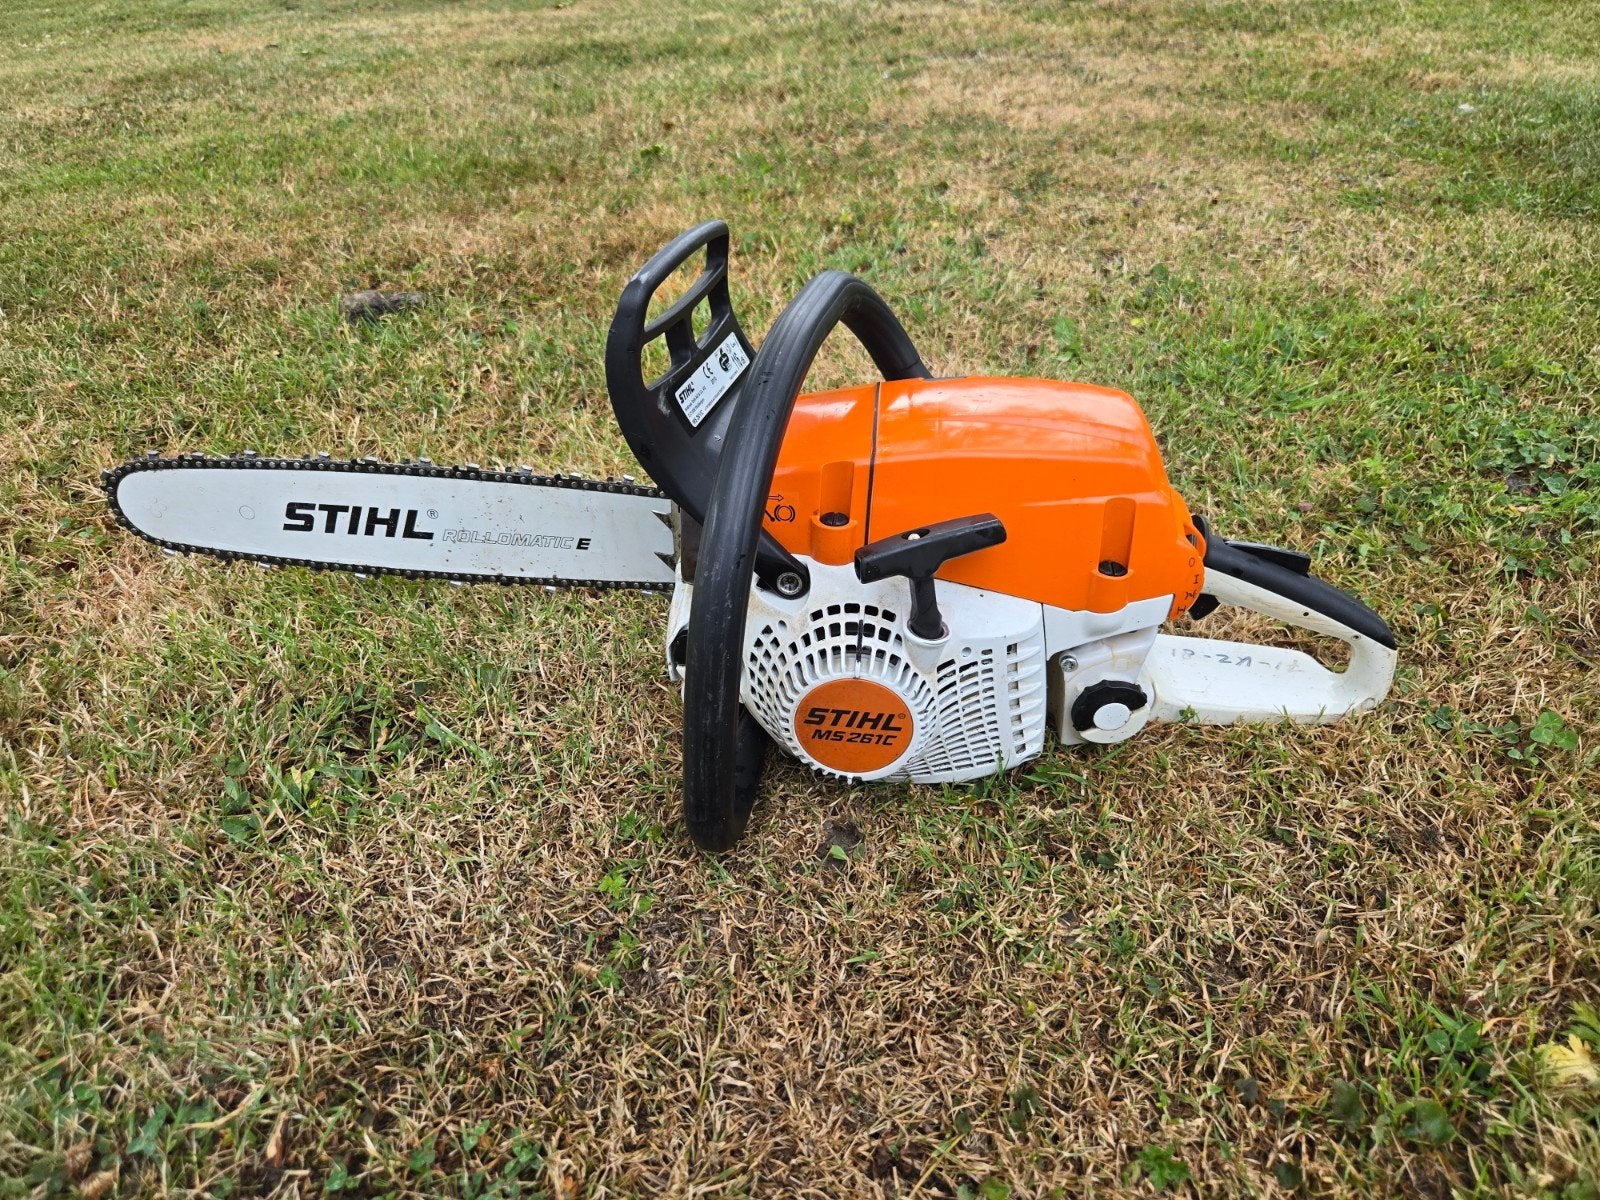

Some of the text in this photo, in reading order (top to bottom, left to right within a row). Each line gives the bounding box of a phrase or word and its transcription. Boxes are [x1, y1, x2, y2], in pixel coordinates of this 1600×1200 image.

[678, 384, 695, 404] STIHL
[282, 501, 434, 540] STIHL
[442, 529, 592, 551] ROLLOMATIC E
[803, 707, 903, 732] STIHL
[811, 729, 898, 746] MS 261C
